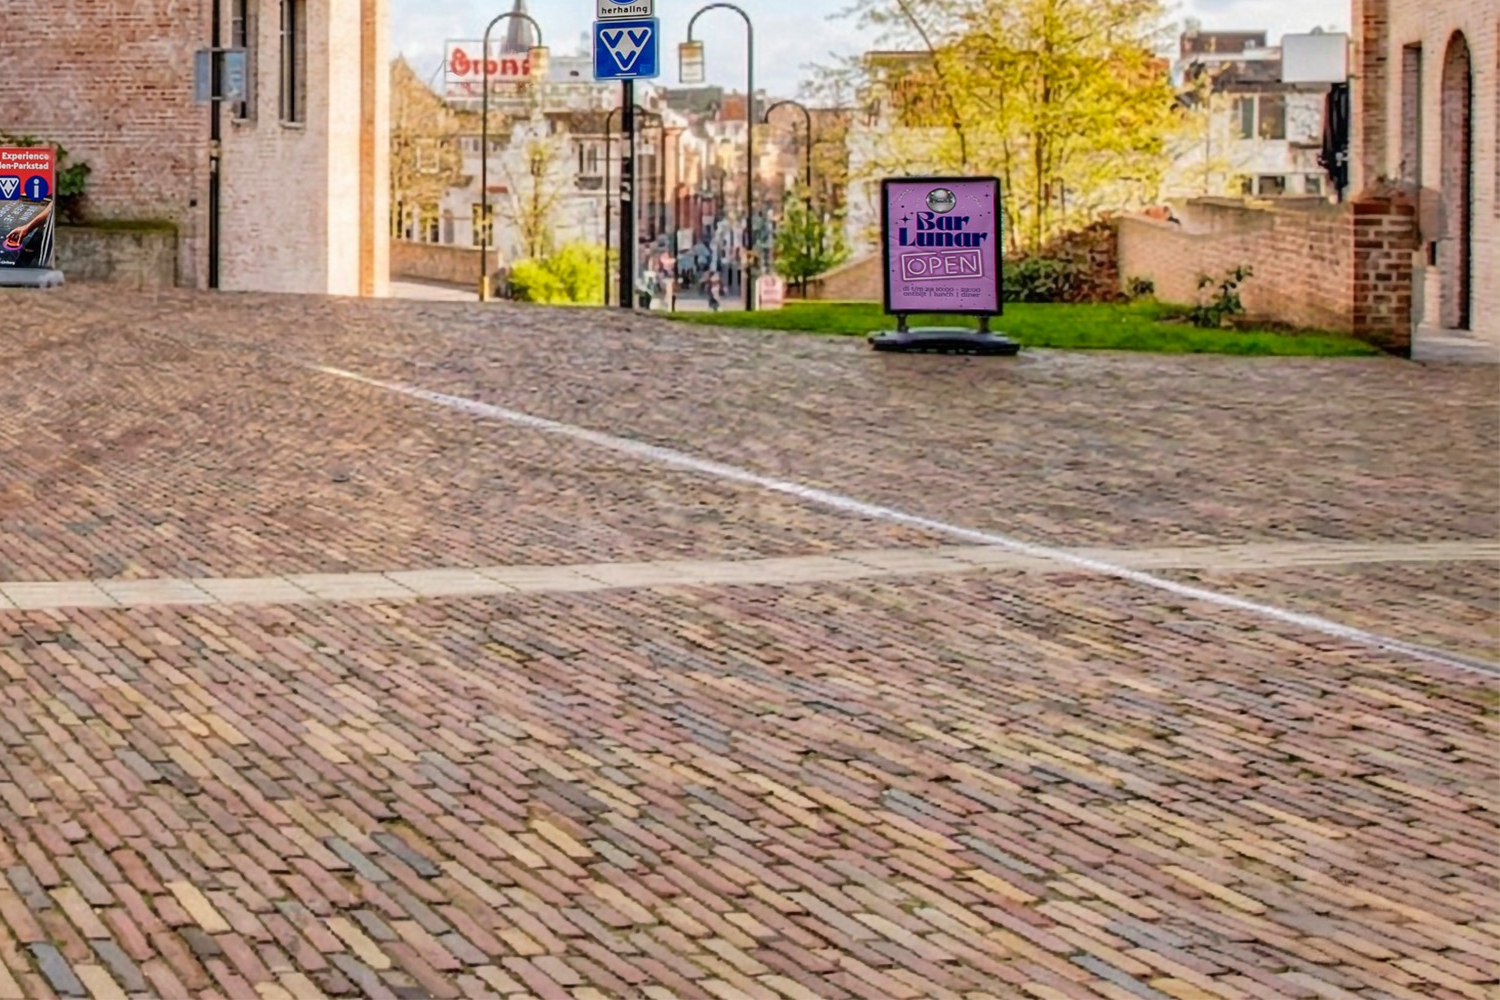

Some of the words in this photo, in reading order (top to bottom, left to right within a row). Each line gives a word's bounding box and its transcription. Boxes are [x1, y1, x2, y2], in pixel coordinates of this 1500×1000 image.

[601, 6, 648, 14] herhaling
[2, 152, 49, 161] Experience
[916, 211, 970, 230] Bar
[898, 228, 988, 247] Lunar
[907, 256, 978, 275] OPEN
